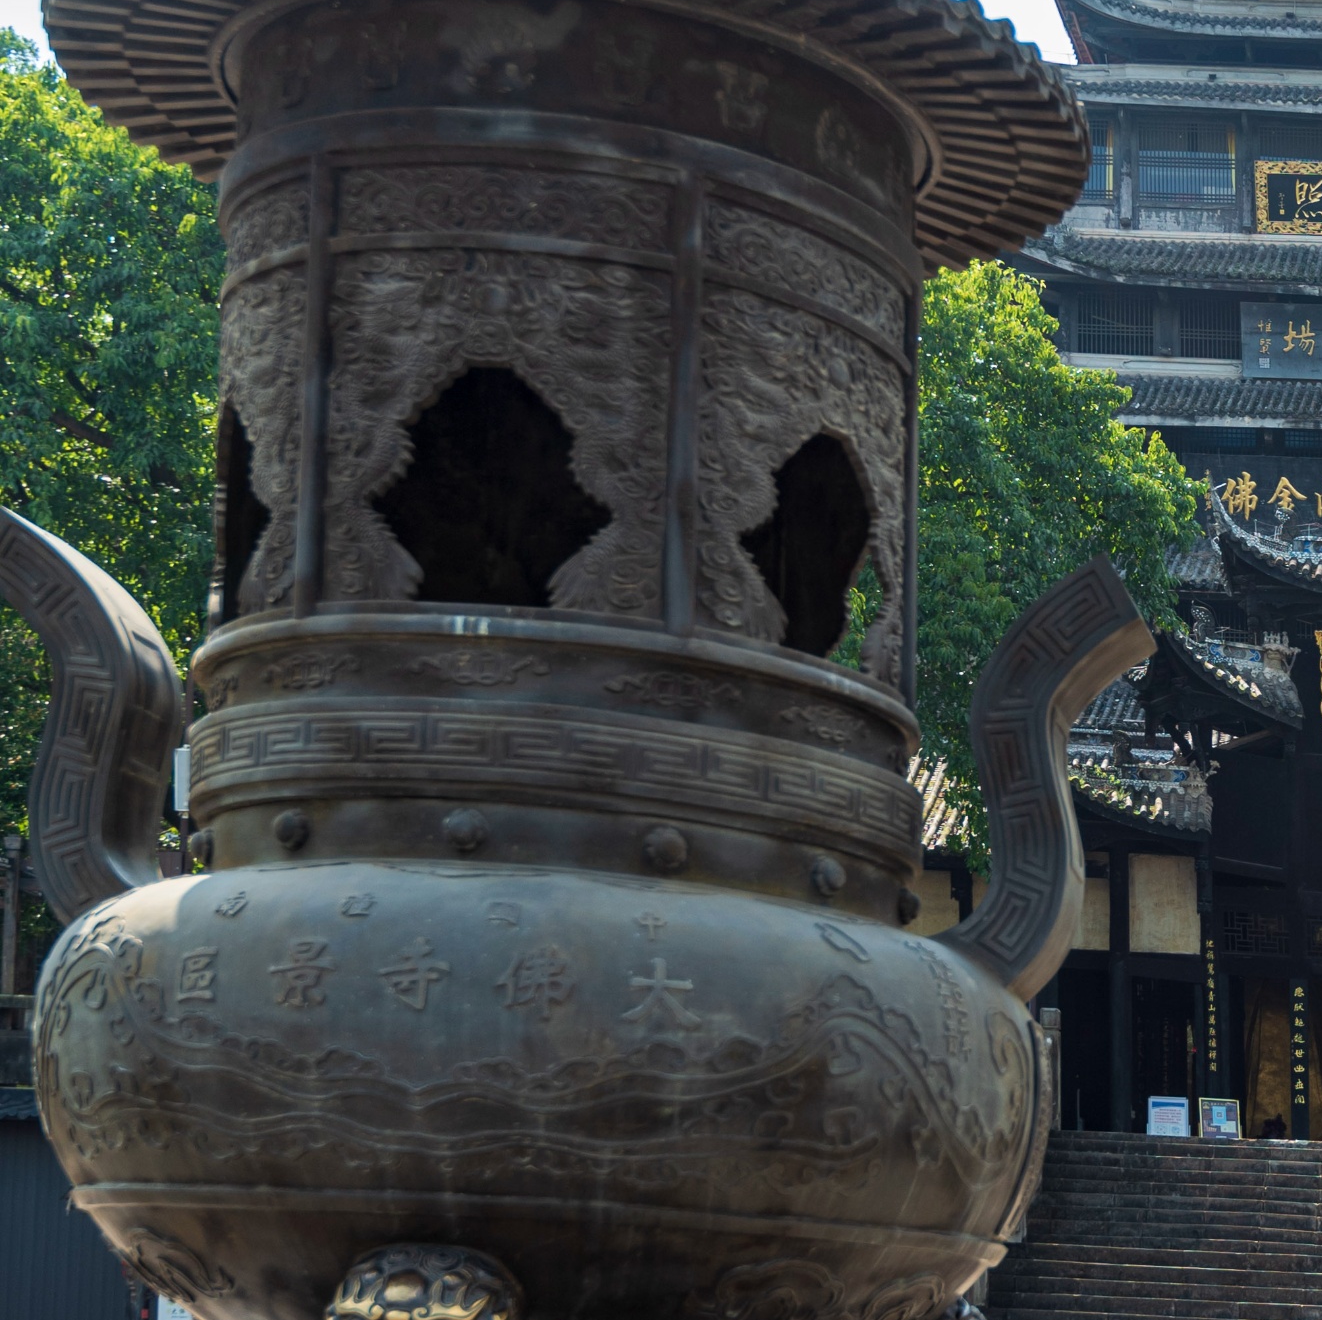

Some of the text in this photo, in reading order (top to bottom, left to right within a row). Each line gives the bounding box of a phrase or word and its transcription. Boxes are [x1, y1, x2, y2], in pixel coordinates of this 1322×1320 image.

[175, 936, 702, 1026] 大佛寺景區
